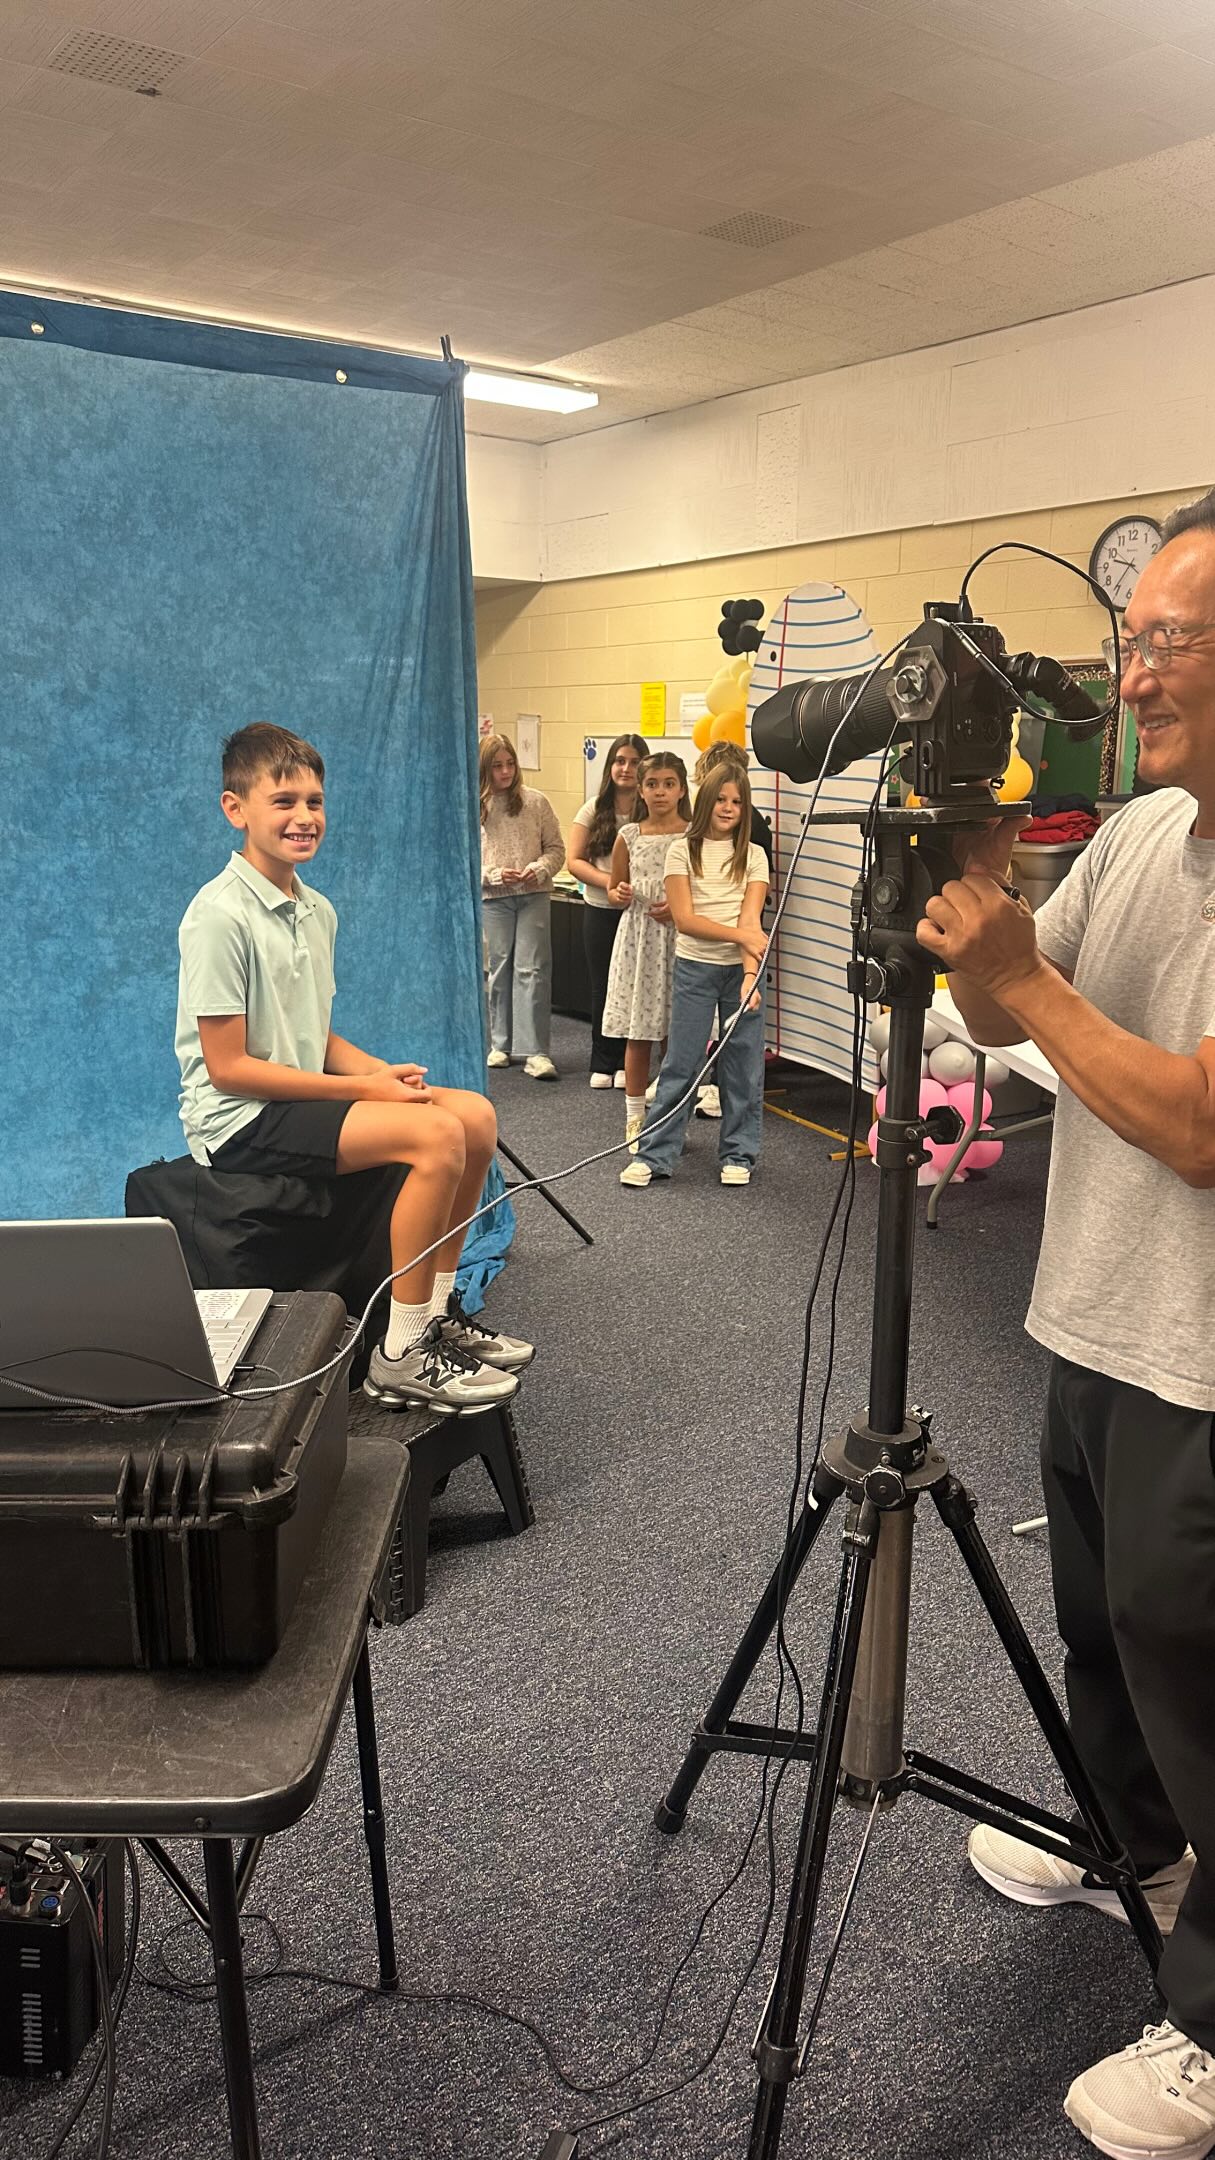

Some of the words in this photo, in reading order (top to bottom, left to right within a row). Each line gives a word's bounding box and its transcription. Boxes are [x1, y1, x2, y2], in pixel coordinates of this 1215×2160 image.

[1118, 535, 1126, 547] 11
[1128, 529, 1139, 541] 12
[1144, 533, 1148, 544] 1
[1108, 547, 1118, 559] 10
[1151, 543, 1158, 555] 2
[1103, 562, 1110, 574] 9
[1105, 575, 1112, 586] 8
[1115, 584, 1121, 596] 7
[1126, 587, 1133, 600] 6
